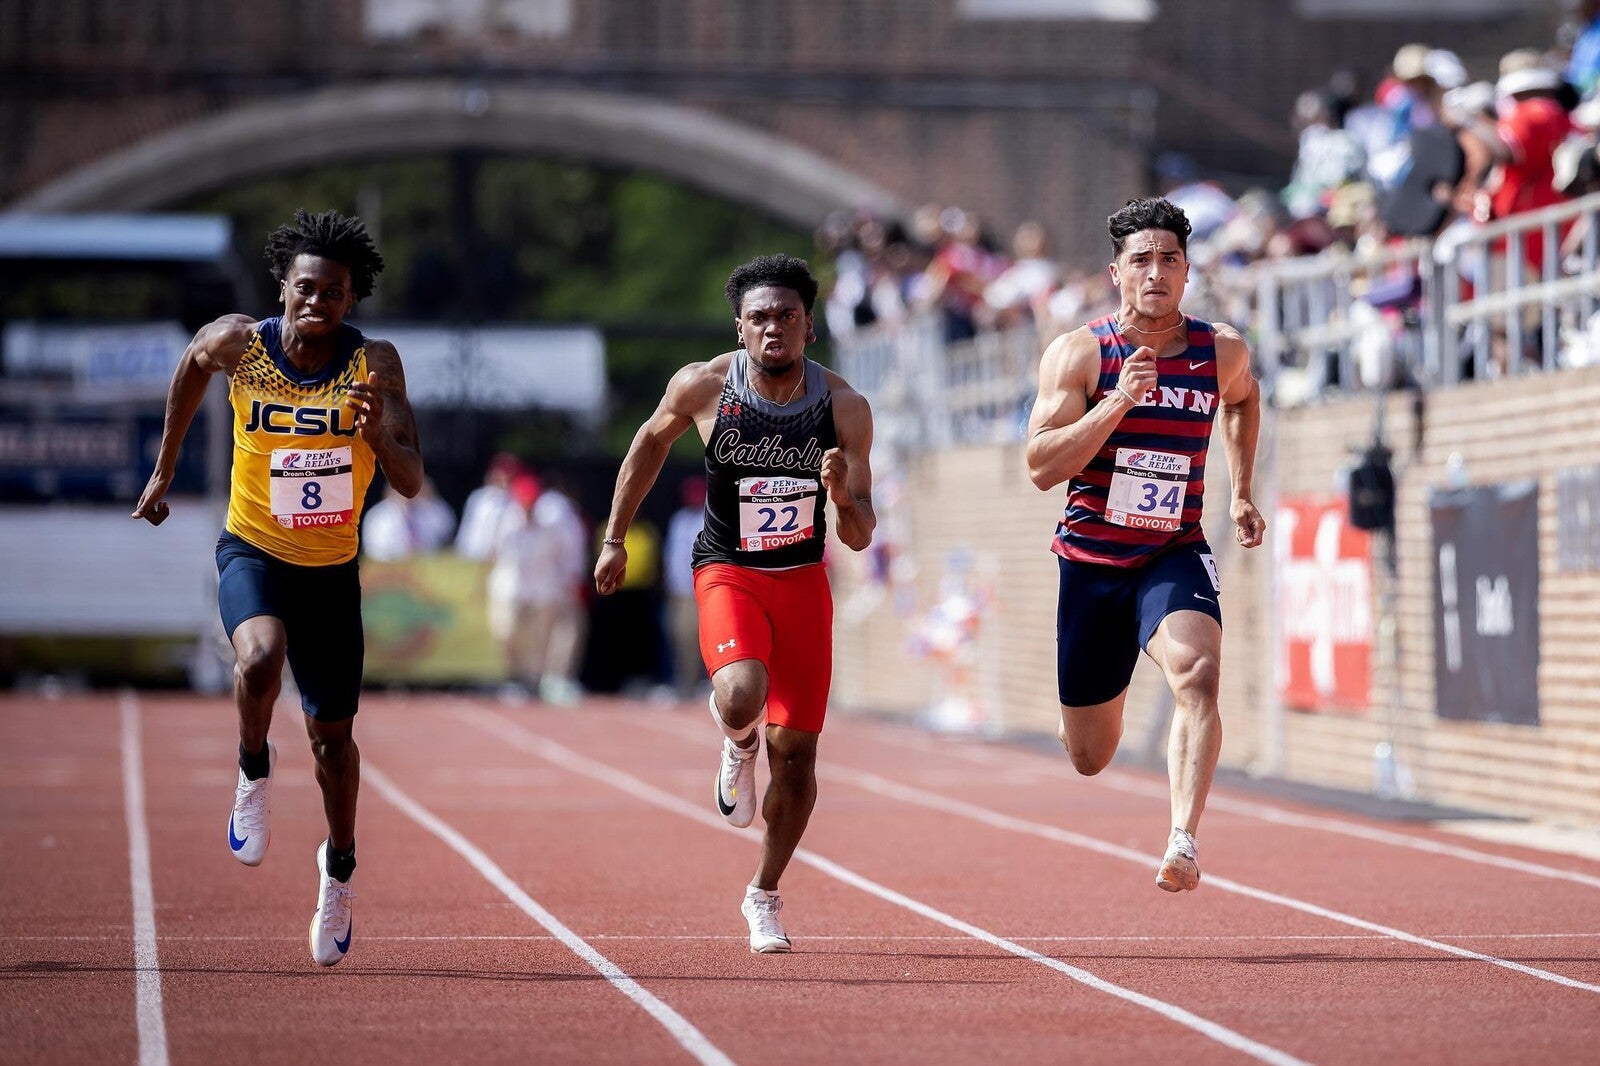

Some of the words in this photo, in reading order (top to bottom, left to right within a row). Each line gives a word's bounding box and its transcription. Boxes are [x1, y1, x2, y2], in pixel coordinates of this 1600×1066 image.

[1103, 386, 1214, 415] ENN
[245, 400, 359, 437] JCSU
[306, 451, 333, 460] PENN
[714, 428, 823, 473] Catholi
[304, 457, 342, 468] RELAYS
[1150, 454, 1176, 463] PENN
[1126, 468, 1147, 477] Dream
[1148, 461, 1182, 472] RELAYS
[771, 485, 808, 494] RELAYS
[773, 480, 798, 488] PENN
[301, 481, 322, 510] 8
[1136, 482, 1180, 515] 34
[295, 514, 343, 526] TOYOTA
[757, 506, 799, 533] 22
[1129, 516, 1173, 530] TOYOTA
[764, 532, 806, 548] TOYOTA
